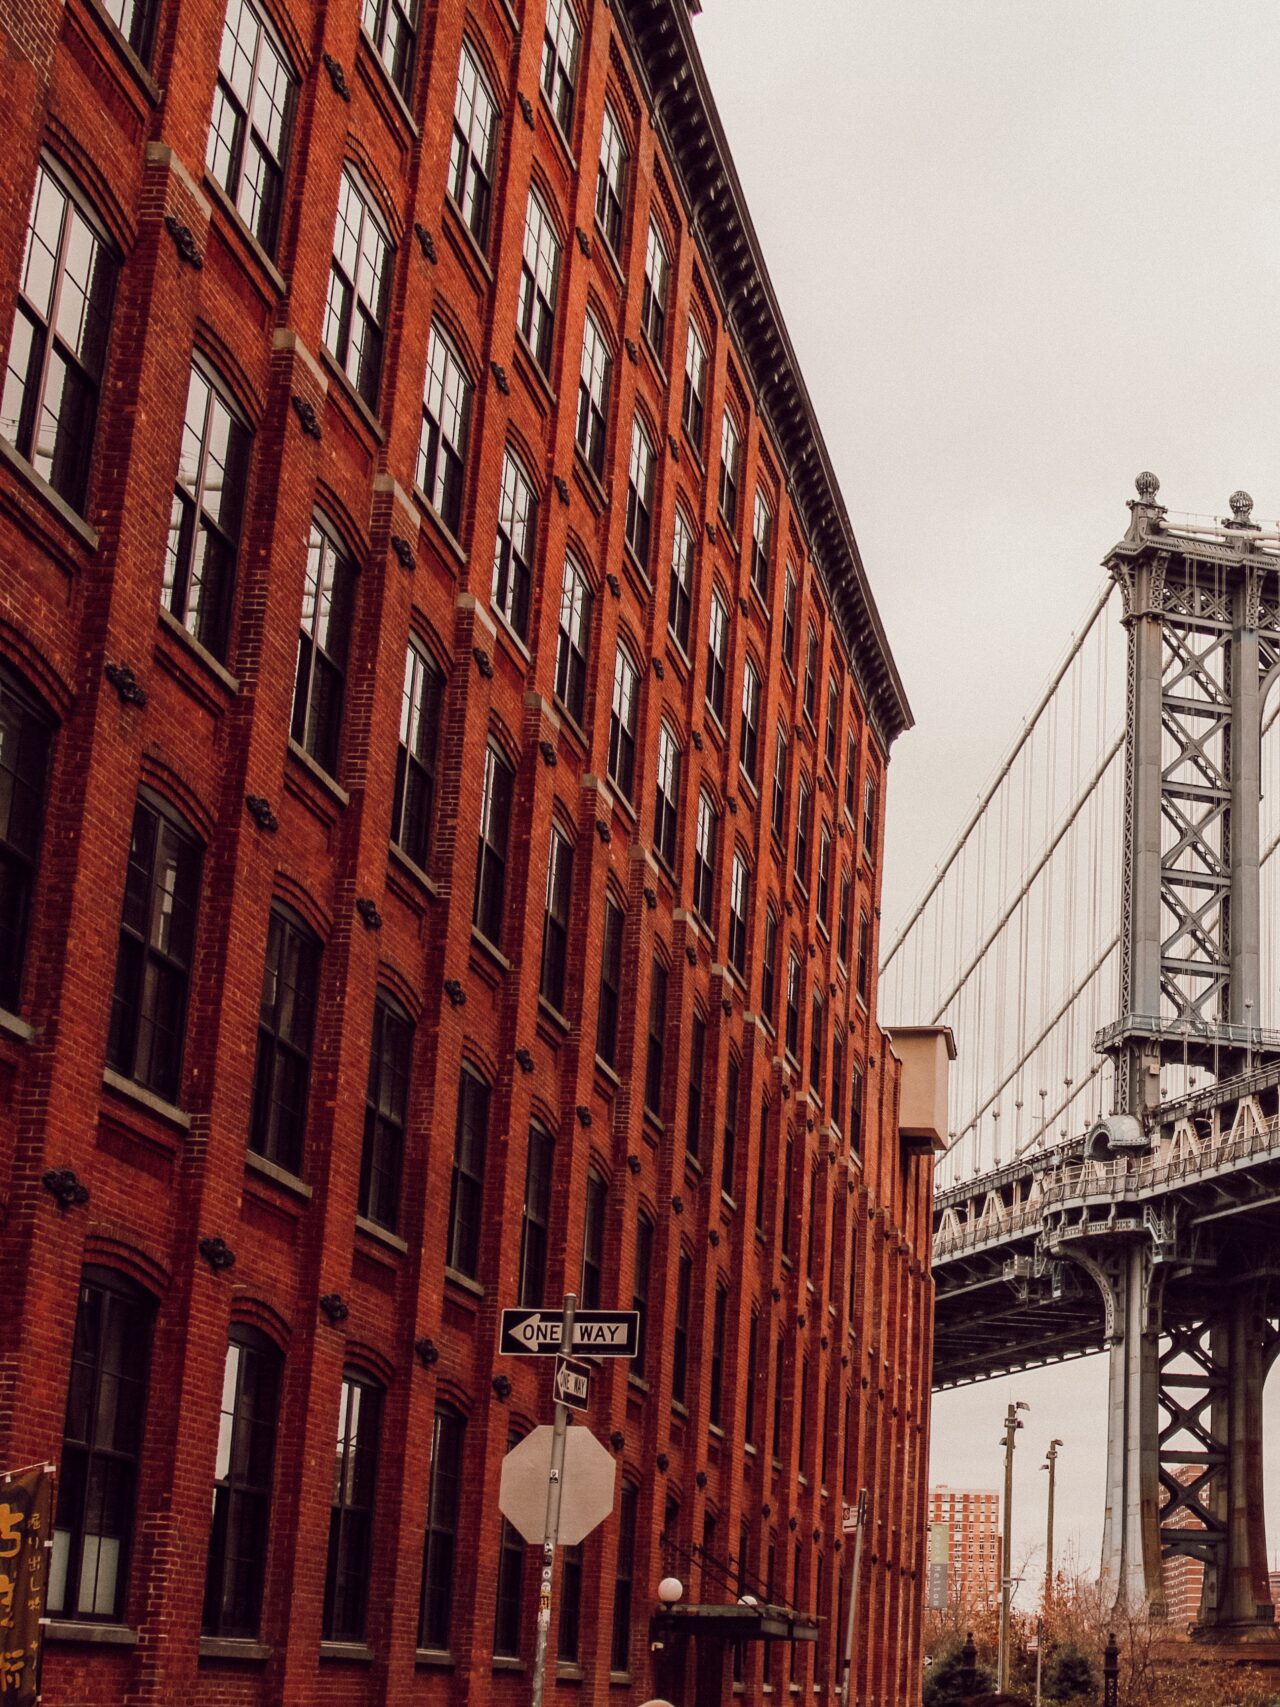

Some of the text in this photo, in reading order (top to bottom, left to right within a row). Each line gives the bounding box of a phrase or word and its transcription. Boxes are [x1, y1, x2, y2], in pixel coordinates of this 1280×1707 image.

[523, 1324, 619, 1342] ONE WAY
[561, 1370, 586, 1396] ONE WAY
